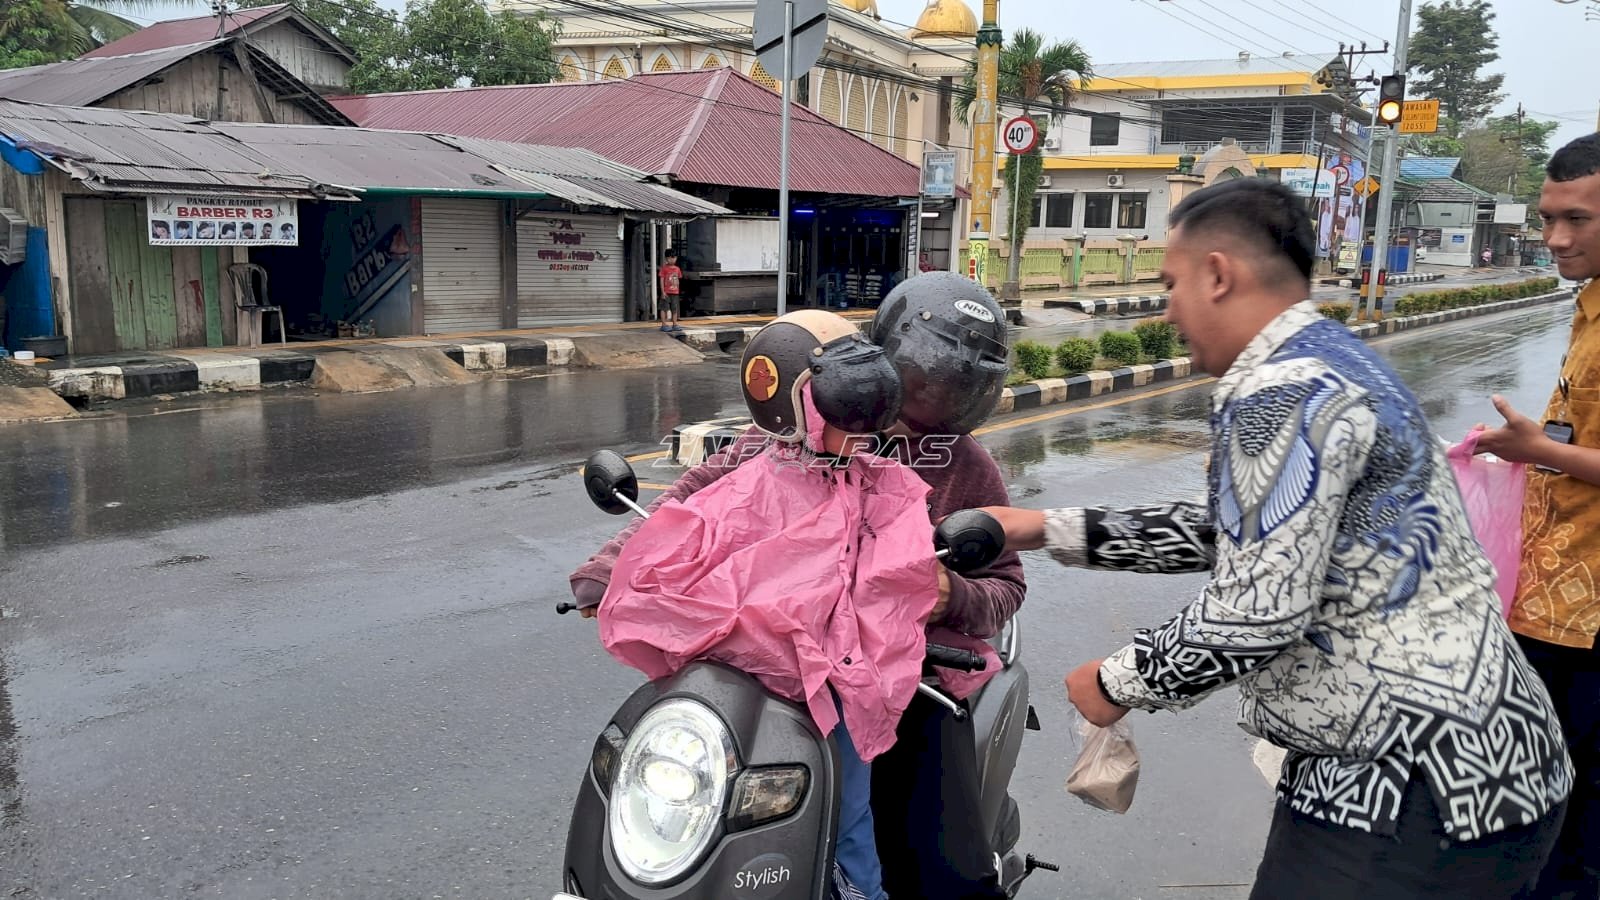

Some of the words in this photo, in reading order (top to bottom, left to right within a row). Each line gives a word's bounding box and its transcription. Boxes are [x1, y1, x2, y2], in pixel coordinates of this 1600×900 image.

[1008, 127, 1024, 143] 40
[177, 206, 247, 218] BARBER
[252, 208, 274, 218] R3
[734, 865, 791, 890] Stylish
